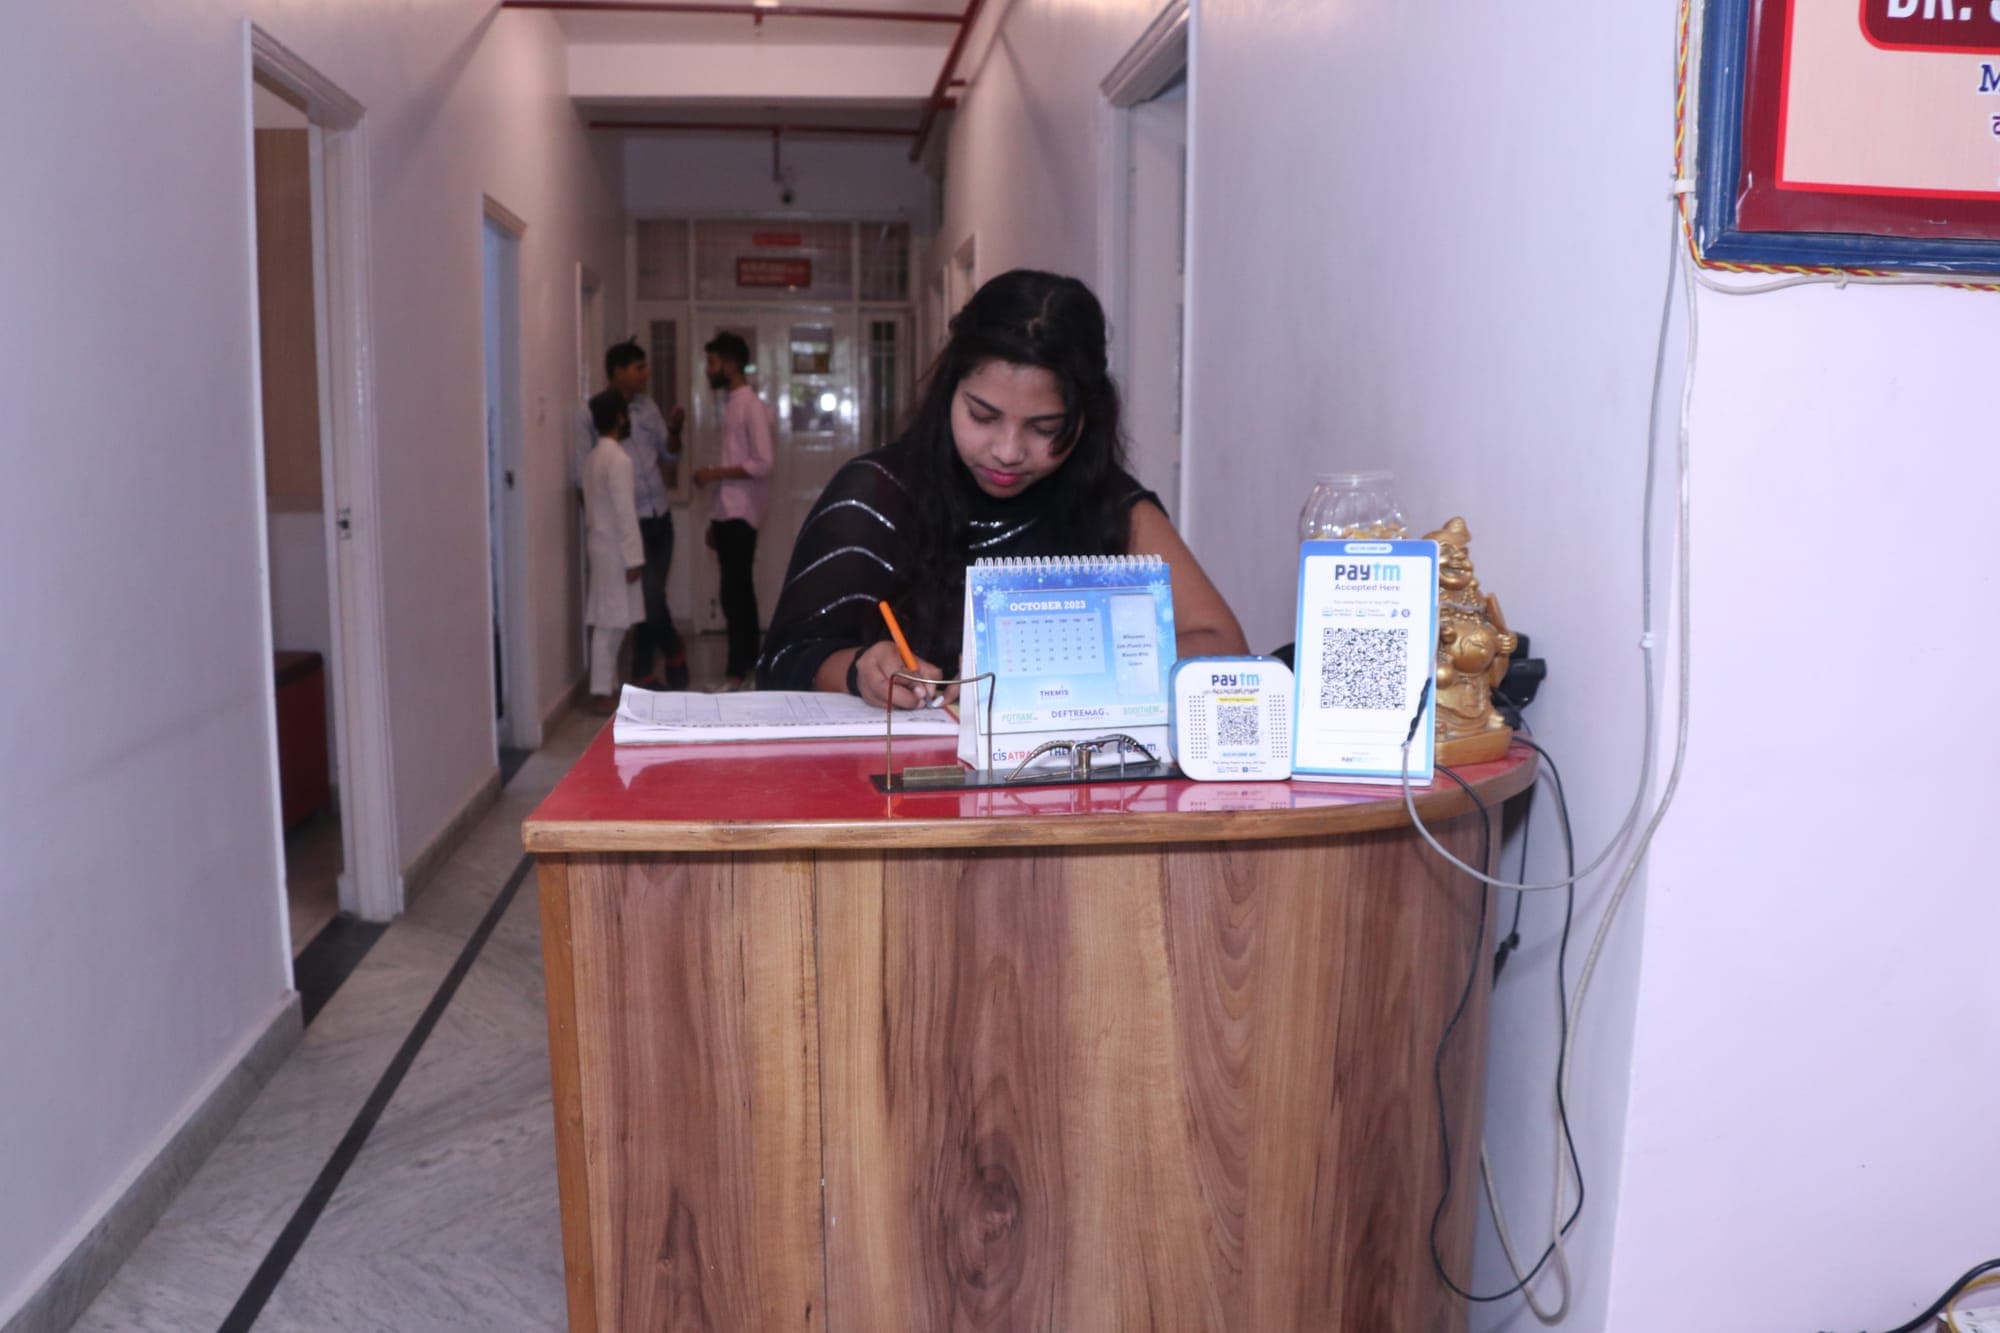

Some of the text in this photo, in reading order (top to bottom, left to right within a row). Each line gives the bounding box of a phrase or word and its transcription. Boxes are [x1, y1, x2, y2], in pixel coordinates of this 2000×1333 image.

[1334, 583, 1400, 592] Accepted Here
[1009, 600, 1087, 612] OCTOBER 2023
[1051, 708, 1105, 719] DEFTREMAG
